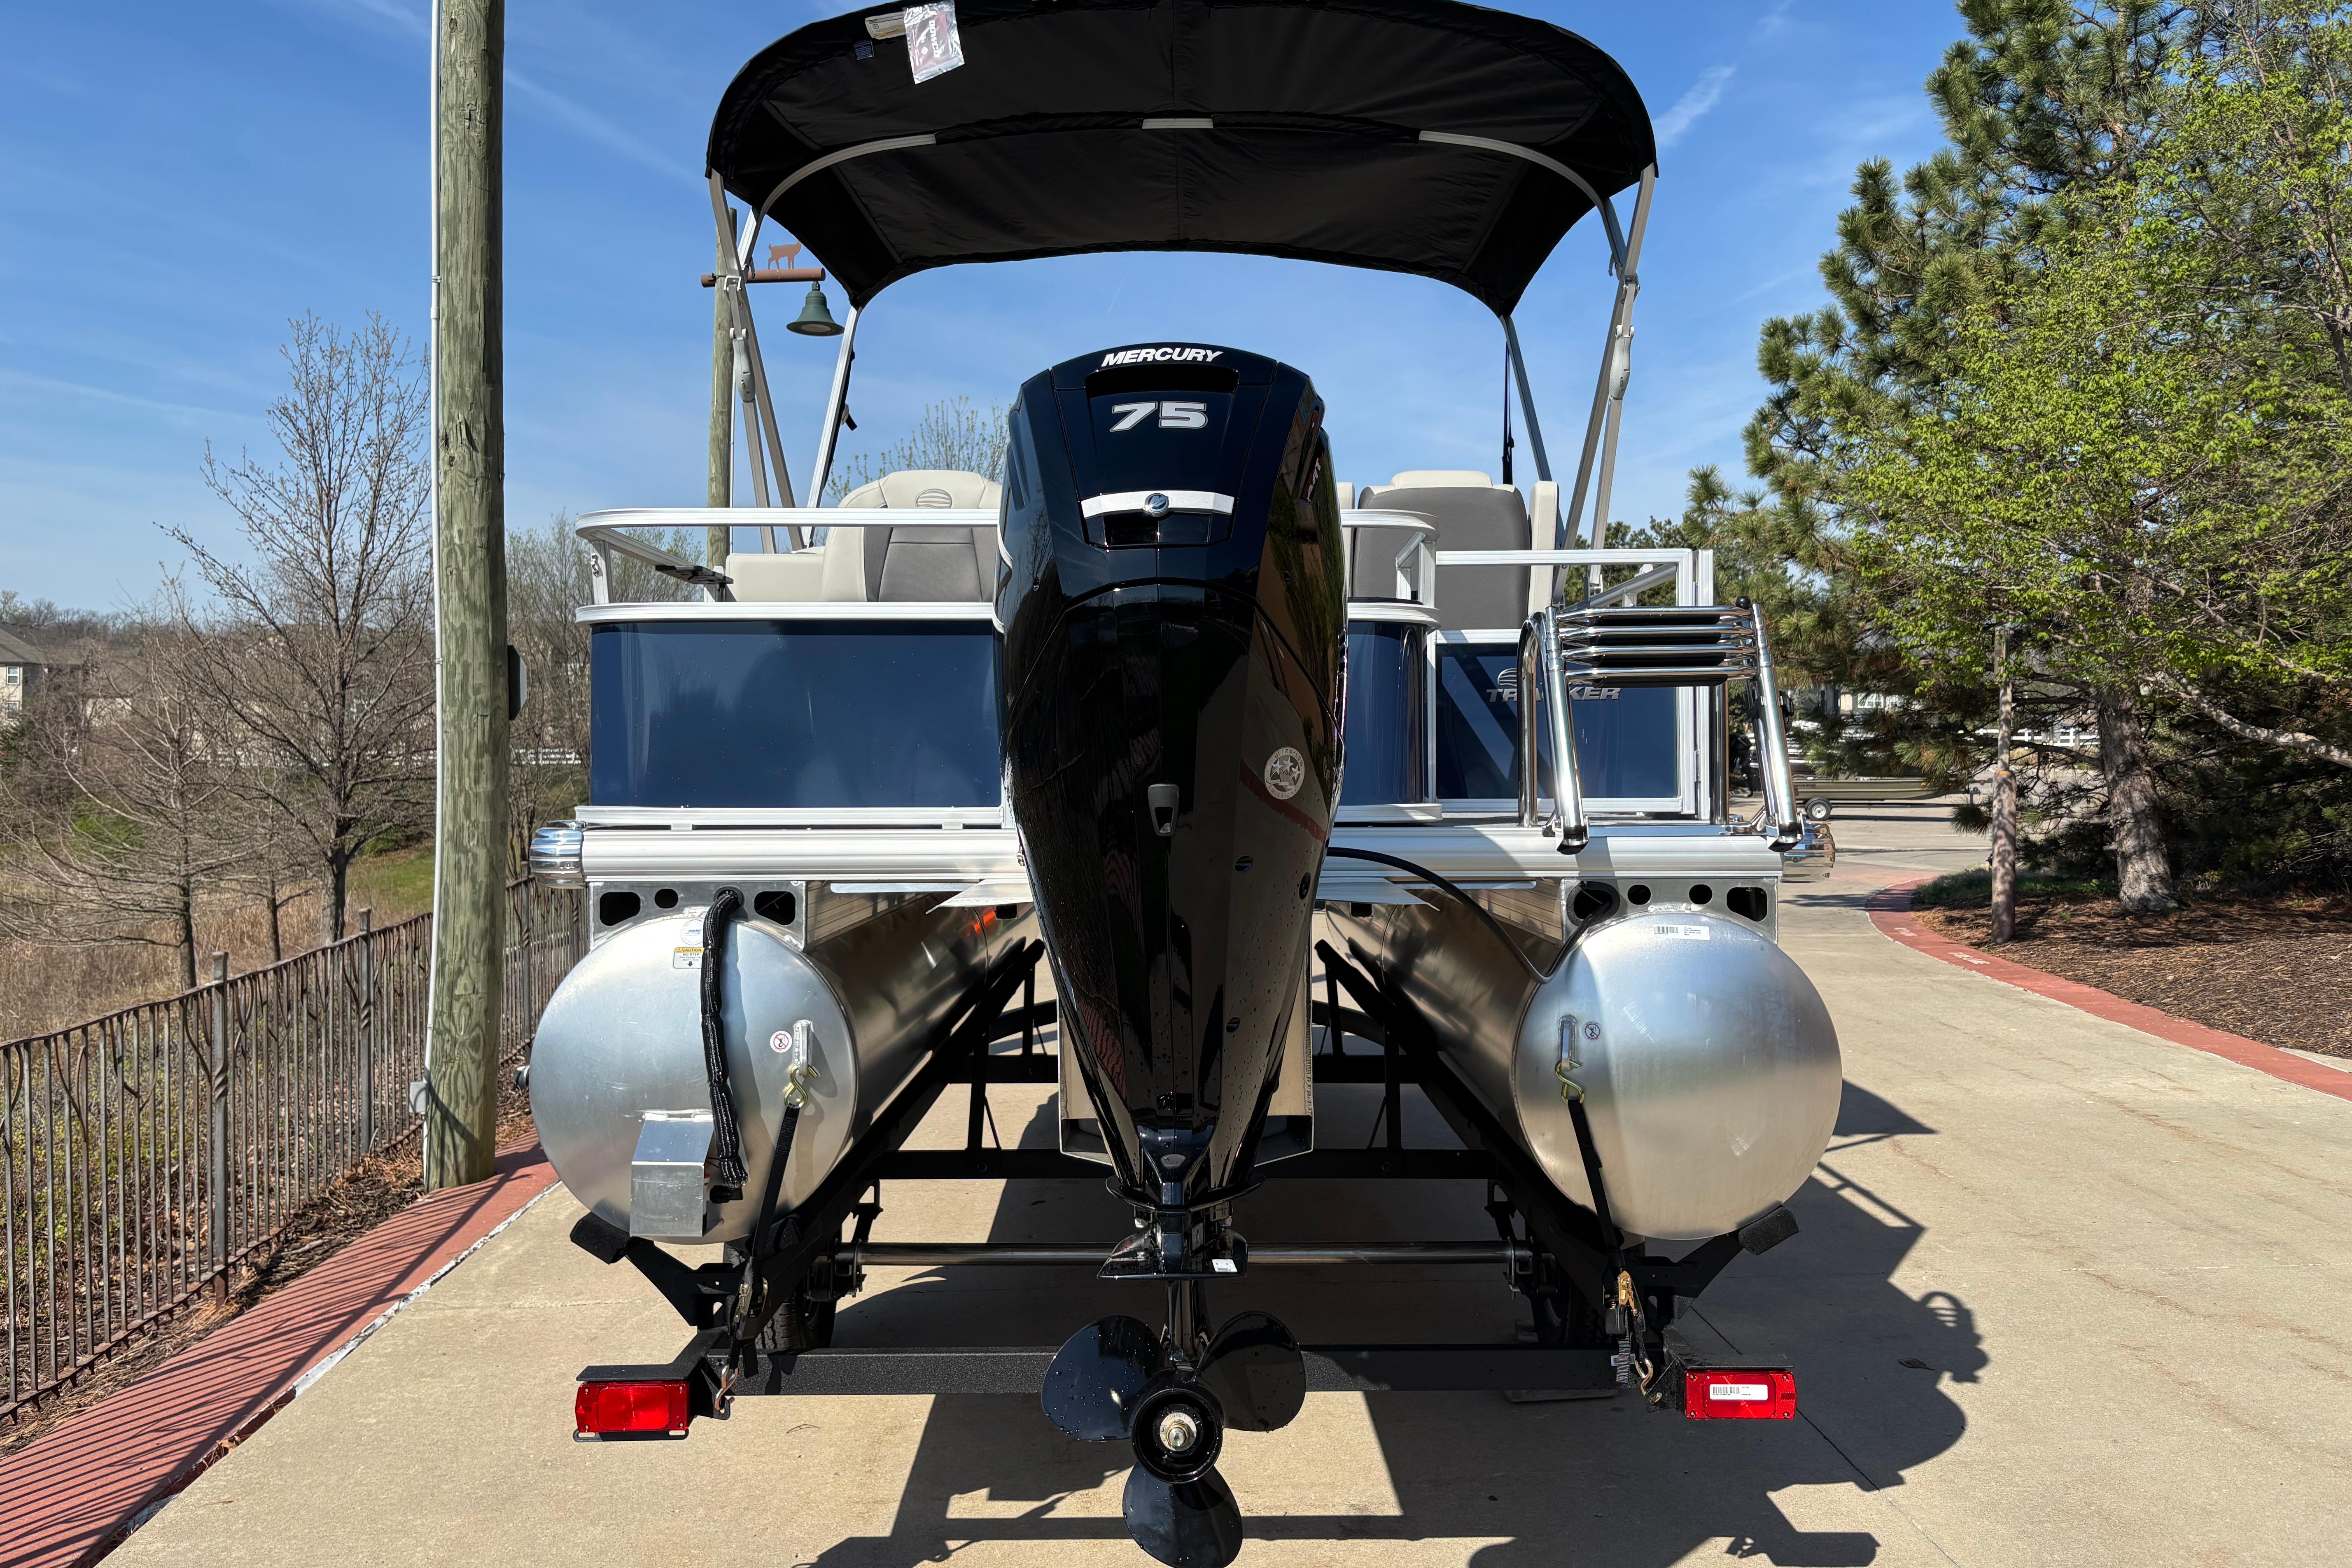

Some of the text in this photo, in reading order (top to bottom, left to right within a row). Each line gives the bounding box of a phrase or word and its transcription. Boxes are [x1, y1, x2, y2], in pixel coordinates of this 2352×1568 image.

[929, 20, 942, 58] DOWCO
[1101, 348, 1223, 367] MERCURY
[1109, 401, 1209, 432] 75
[1486, 687, 1621, 702] TRKER
[1274, 748, 1292, 758] ULTRA
